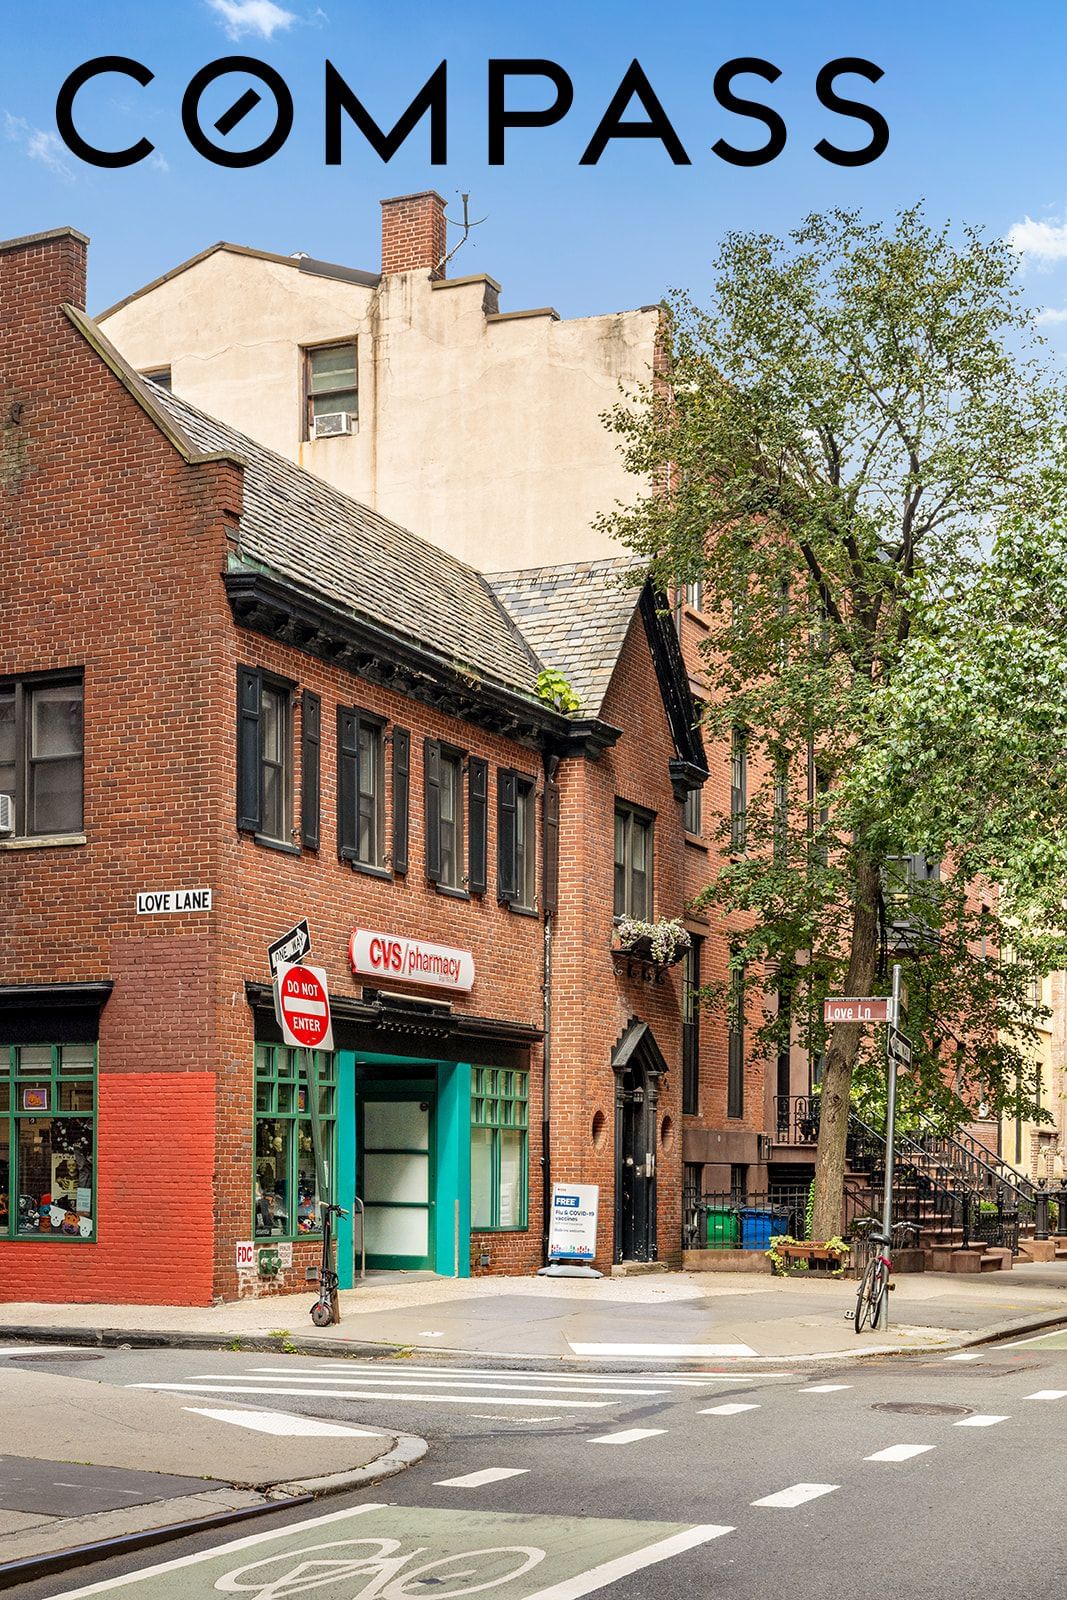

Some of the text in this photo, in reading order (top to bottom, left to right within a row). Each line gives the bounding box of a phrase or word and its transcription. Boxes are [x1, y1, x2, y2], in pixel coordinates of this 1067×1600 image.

[138, 891, 210, 912] LOVE LANE
[274, 932, 304, 962] ONE WAY
[287, 980, 319, 997] DO NOT
[827, 1004, 871, 1020] Love Ln
[292, 1016, 321, 1032] ENTER
[556, 1198, 577, 1206] FREE
[238, 1246, 252, 1262] FDC
